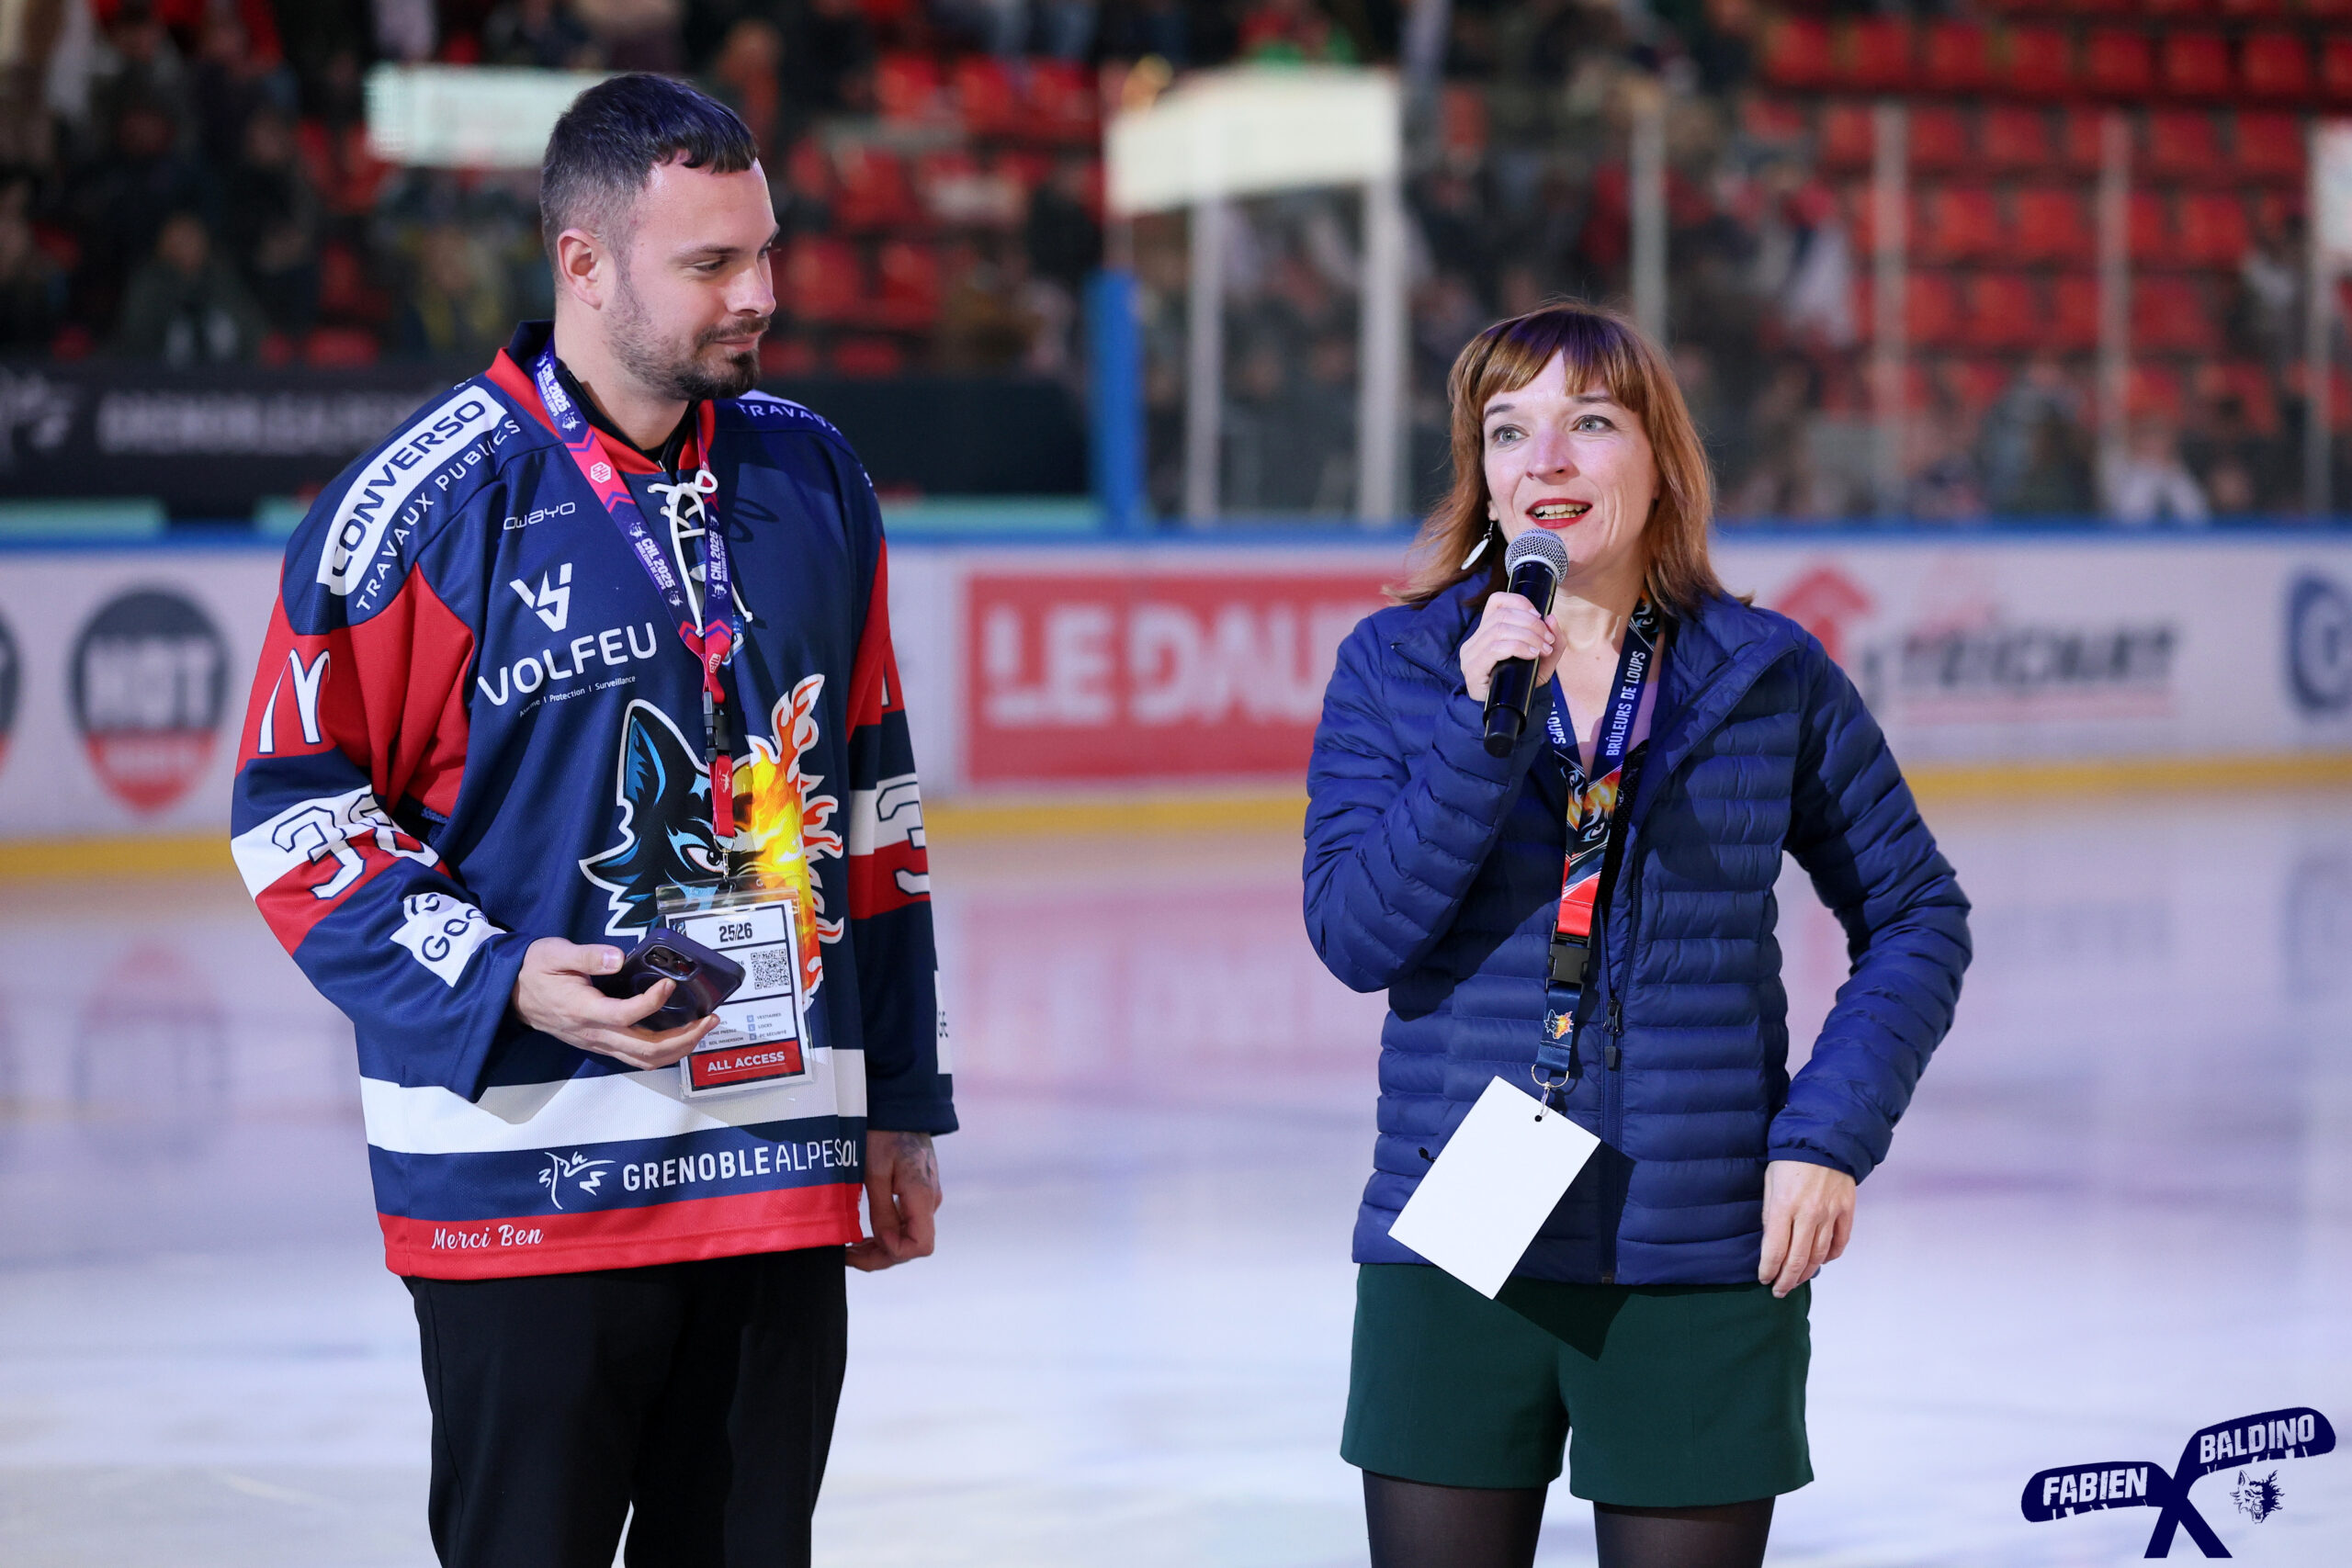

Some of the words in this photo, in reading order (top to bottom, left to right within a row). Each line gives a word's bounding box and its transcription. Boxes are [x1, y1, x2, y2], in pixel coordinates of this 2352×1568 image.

[548, 381, 571, 412] 2025
[332, 400, 486, 578] CONVERSO
[356, 491, 435, 612] TRAVAUX
[709, 530, 720, 560] 2025
[641, 537, 661, 560] CHL
[653, 558, 676, 588] 2025
[710, 560, 722, 581] CHL
[477, 622, 657, 706] VOLFEU
[981, 602, 1114, 728] LE
[1625, 650, 1646, 684] LOUPS
[549, 687, 585, 703] Protection
[594, 675, 636, 691] Surveillance
[1621, 686, 1636, 700] DE
[1606, 703, 1632, 756] BRÛLEURS
[707, 1059, 732, 1072] ALL
[735, 1051, 786, 1068] ACCESS
[431, 1226, 491, 1249] Merci
[498, 1224, 544, 1247] Ben
